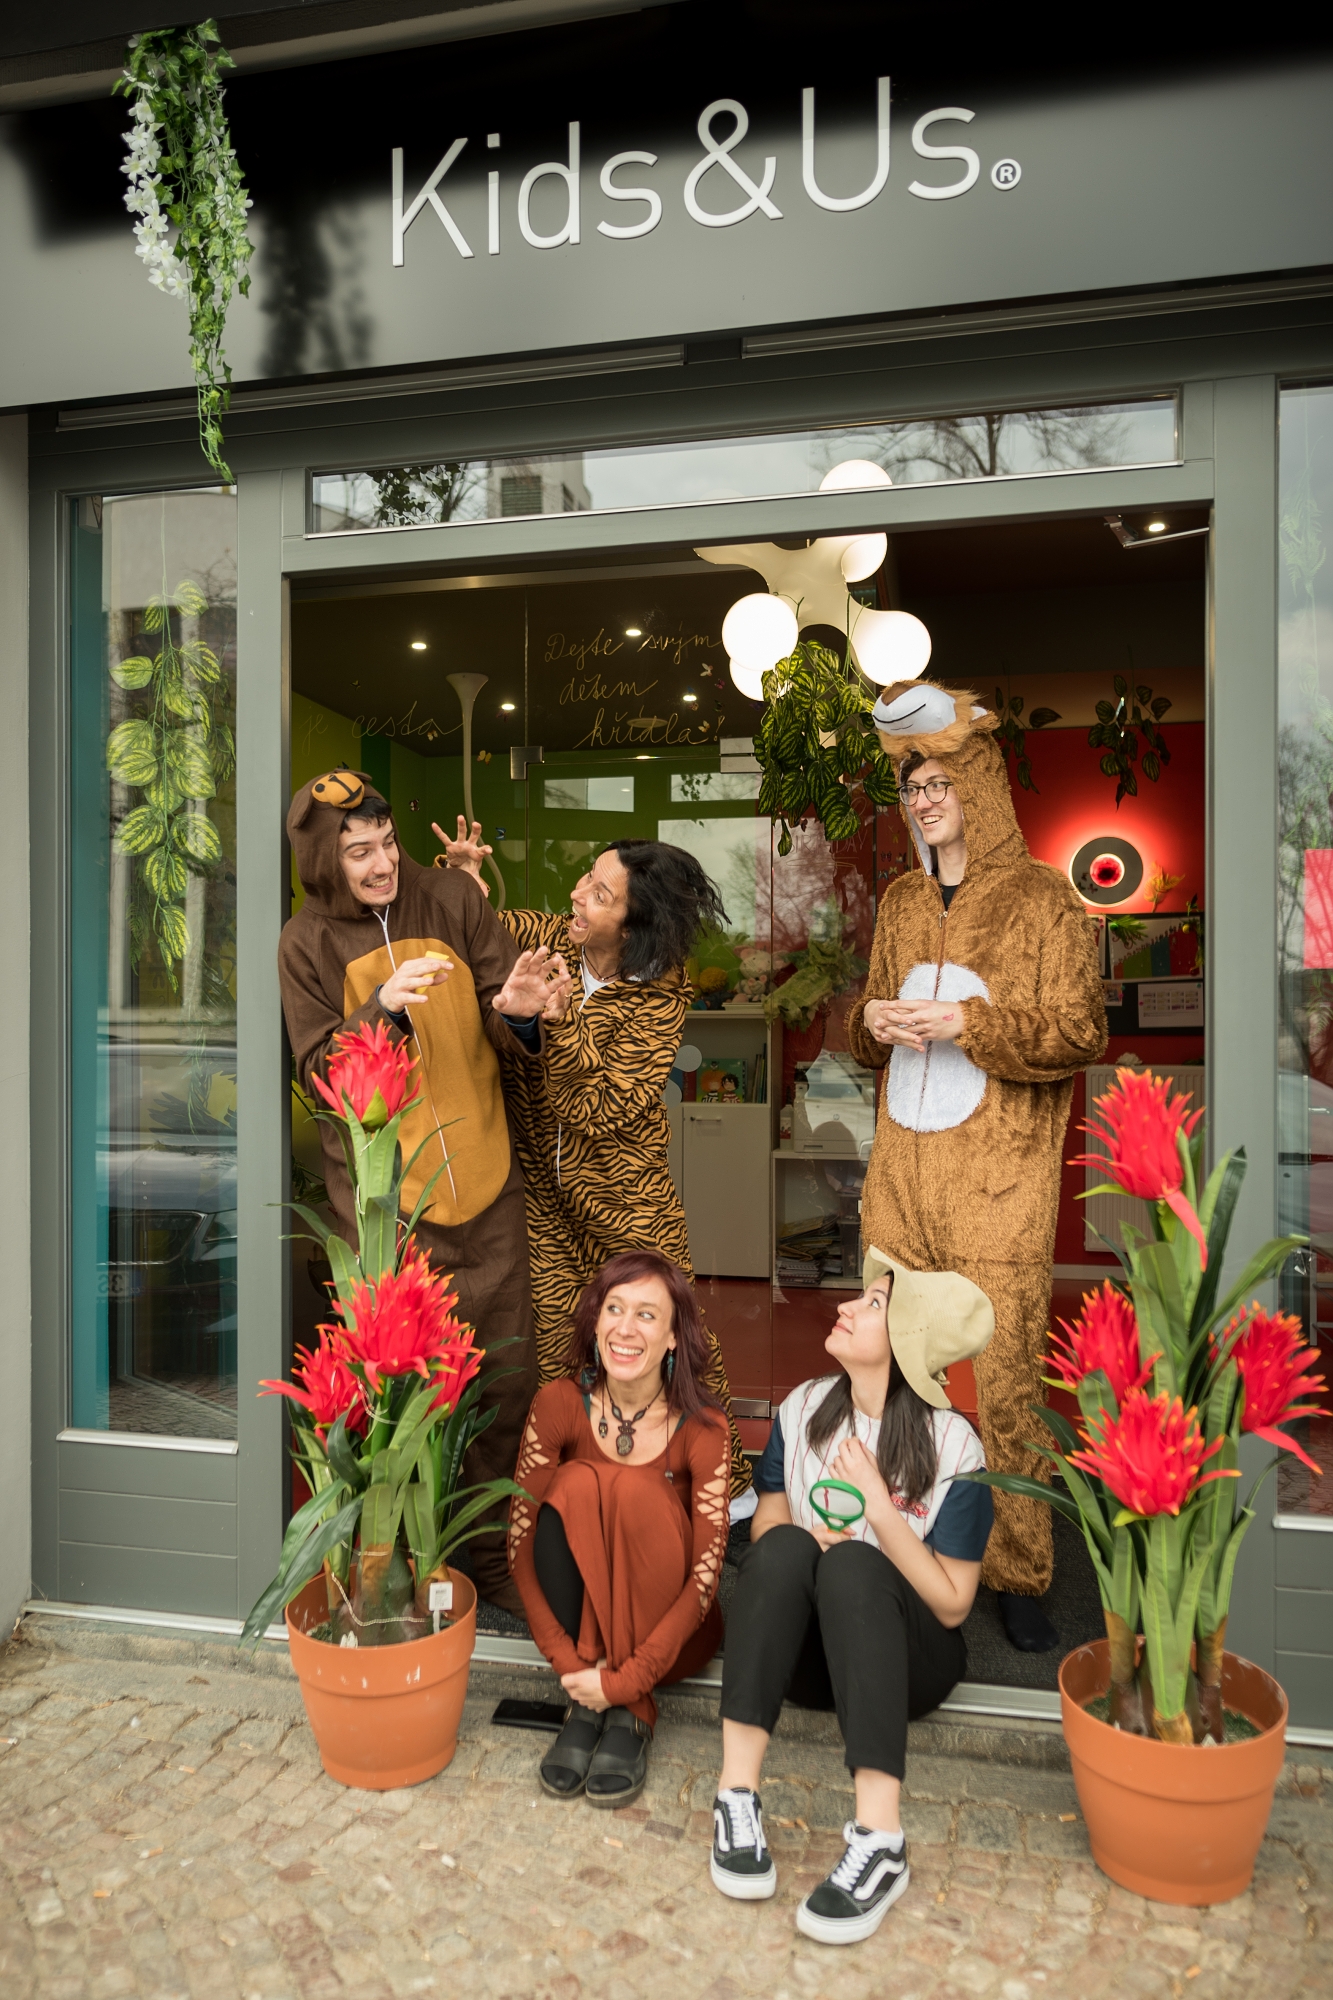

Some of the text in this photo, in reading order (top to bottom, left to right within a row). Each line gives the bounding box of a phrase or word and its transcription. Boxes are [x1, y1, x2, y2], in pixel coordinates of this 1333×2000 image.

[545, 621, 722, 670] Dejte svým
[560, 674, 658, 705] dětem
